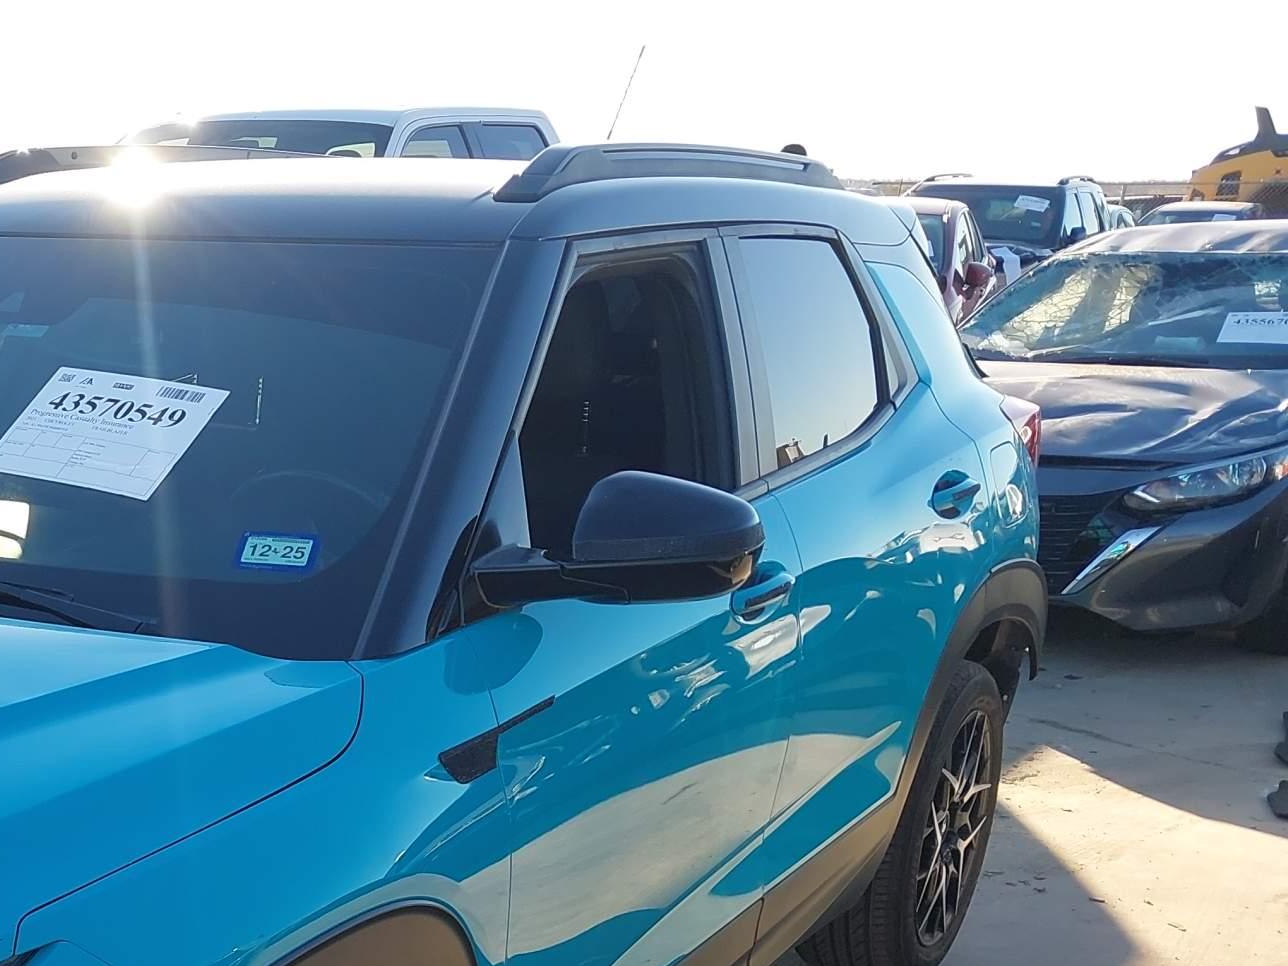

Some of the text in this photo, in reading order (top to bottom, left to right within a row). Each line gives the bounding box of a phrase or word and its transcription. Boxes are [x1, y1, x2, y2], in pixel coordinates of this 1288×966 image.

[31, 408, 69, 420] Progressive
[70, 413, 98, 425] Casualty
[100, 418, 135, 430] Insurance
[48, 391, 187, 428] 43570549
